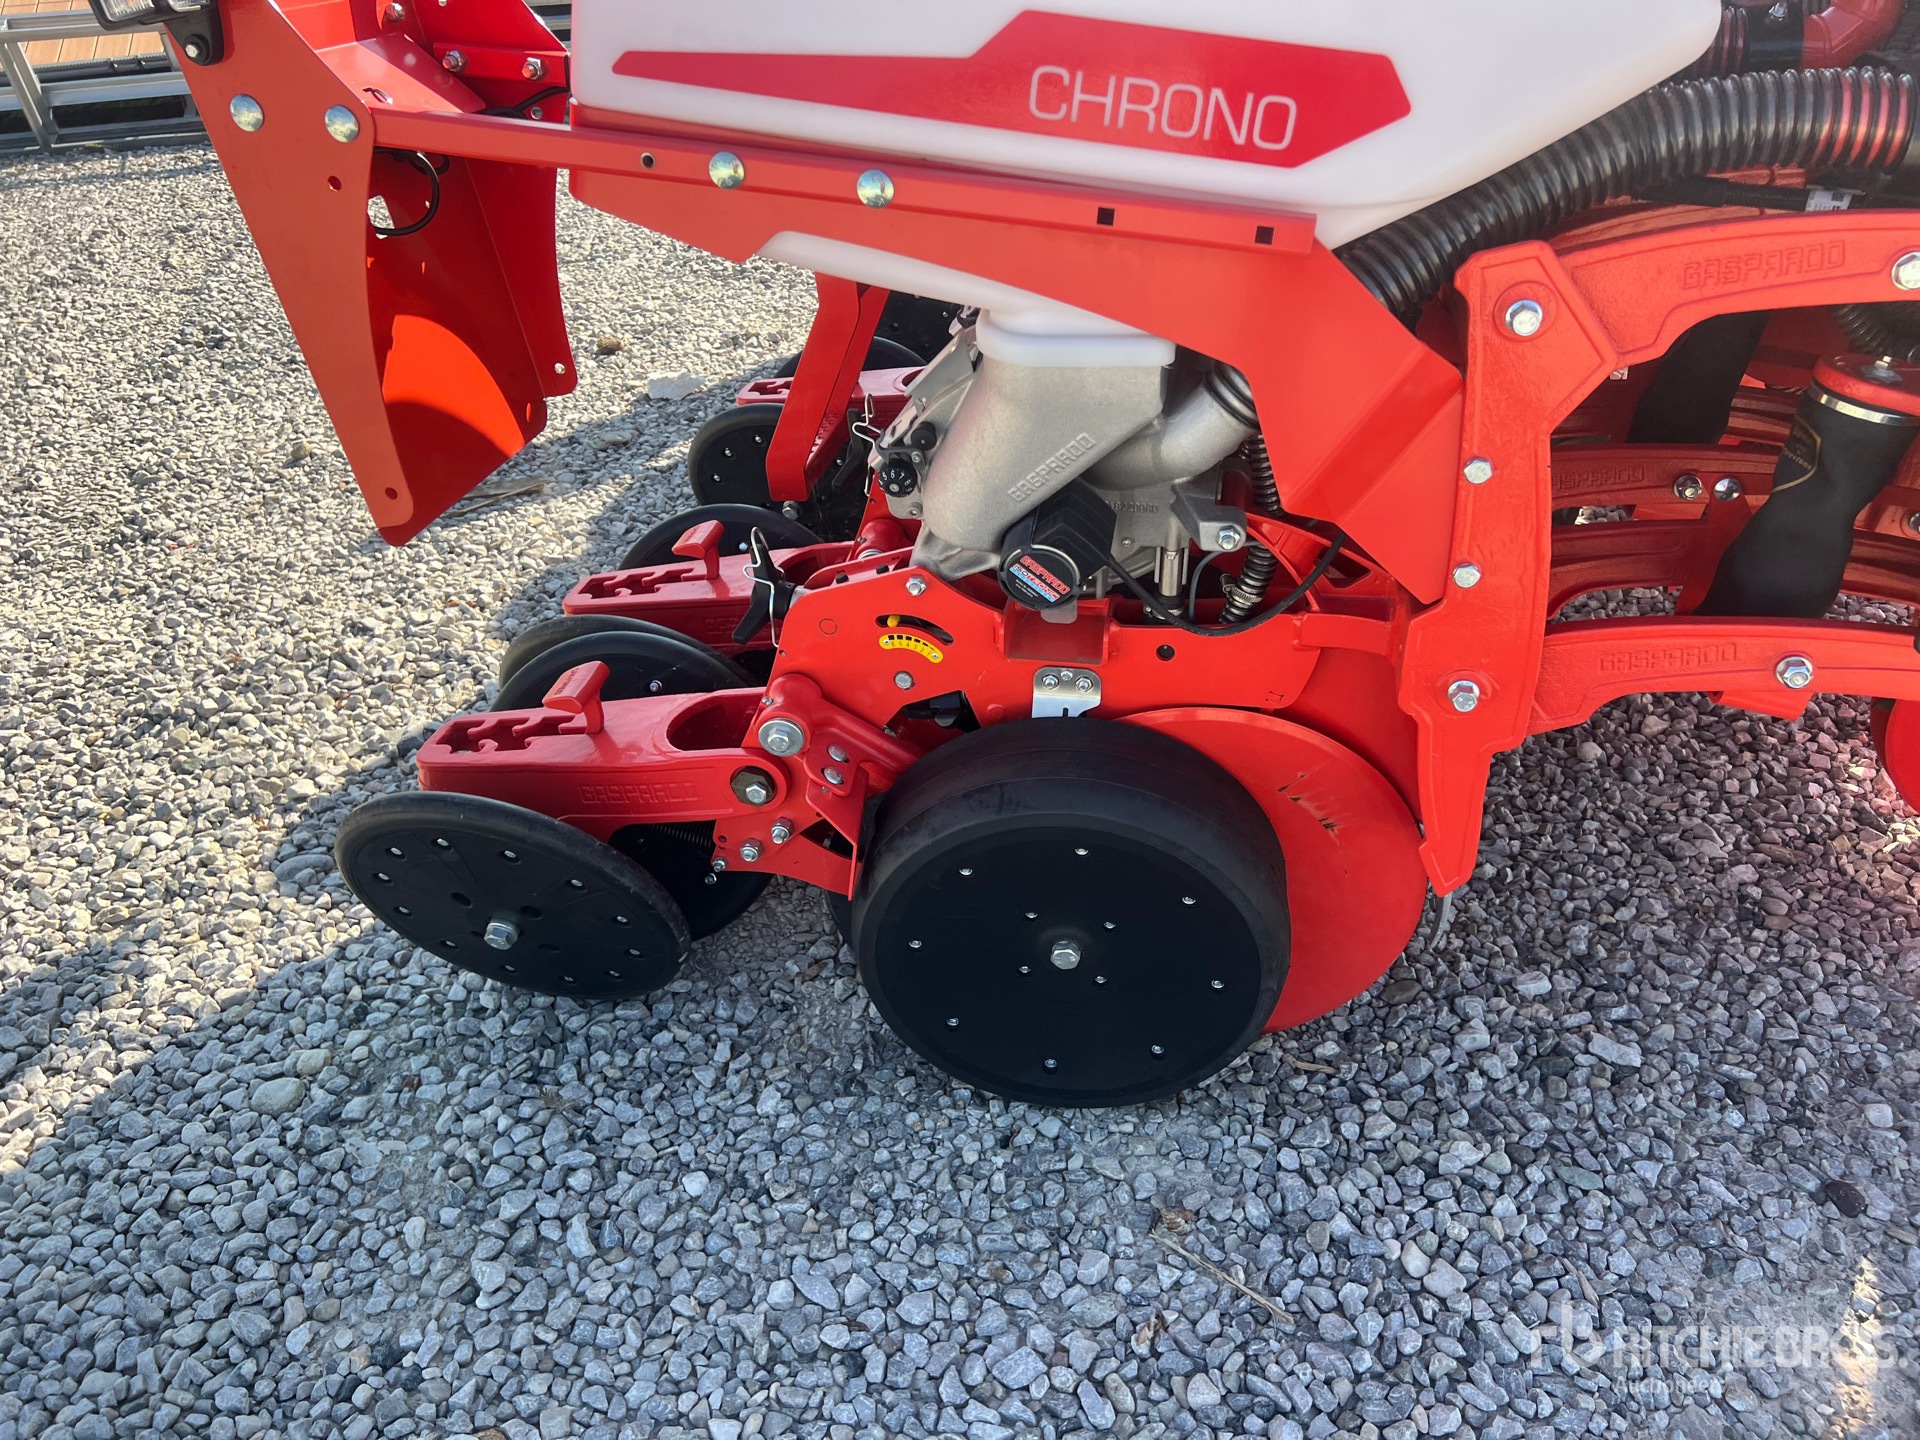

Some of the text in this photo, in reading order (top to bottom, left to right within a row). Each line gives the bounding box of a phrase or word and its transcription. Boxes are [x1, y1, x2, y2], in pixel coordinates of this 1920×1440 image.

[1028, 64, 1298, 151] CHRONO
[1682, 239, 1846, 291] GASPARDO
[898, 472, 905, 480] 7
[1007, 431, 1098, 503] GASPARDO
[1020, 555, 1071, 595] GASPARDO
[1600, 642, 1737, 672] GASPARDO
[577, 782, 700, 804] GASPARDO
